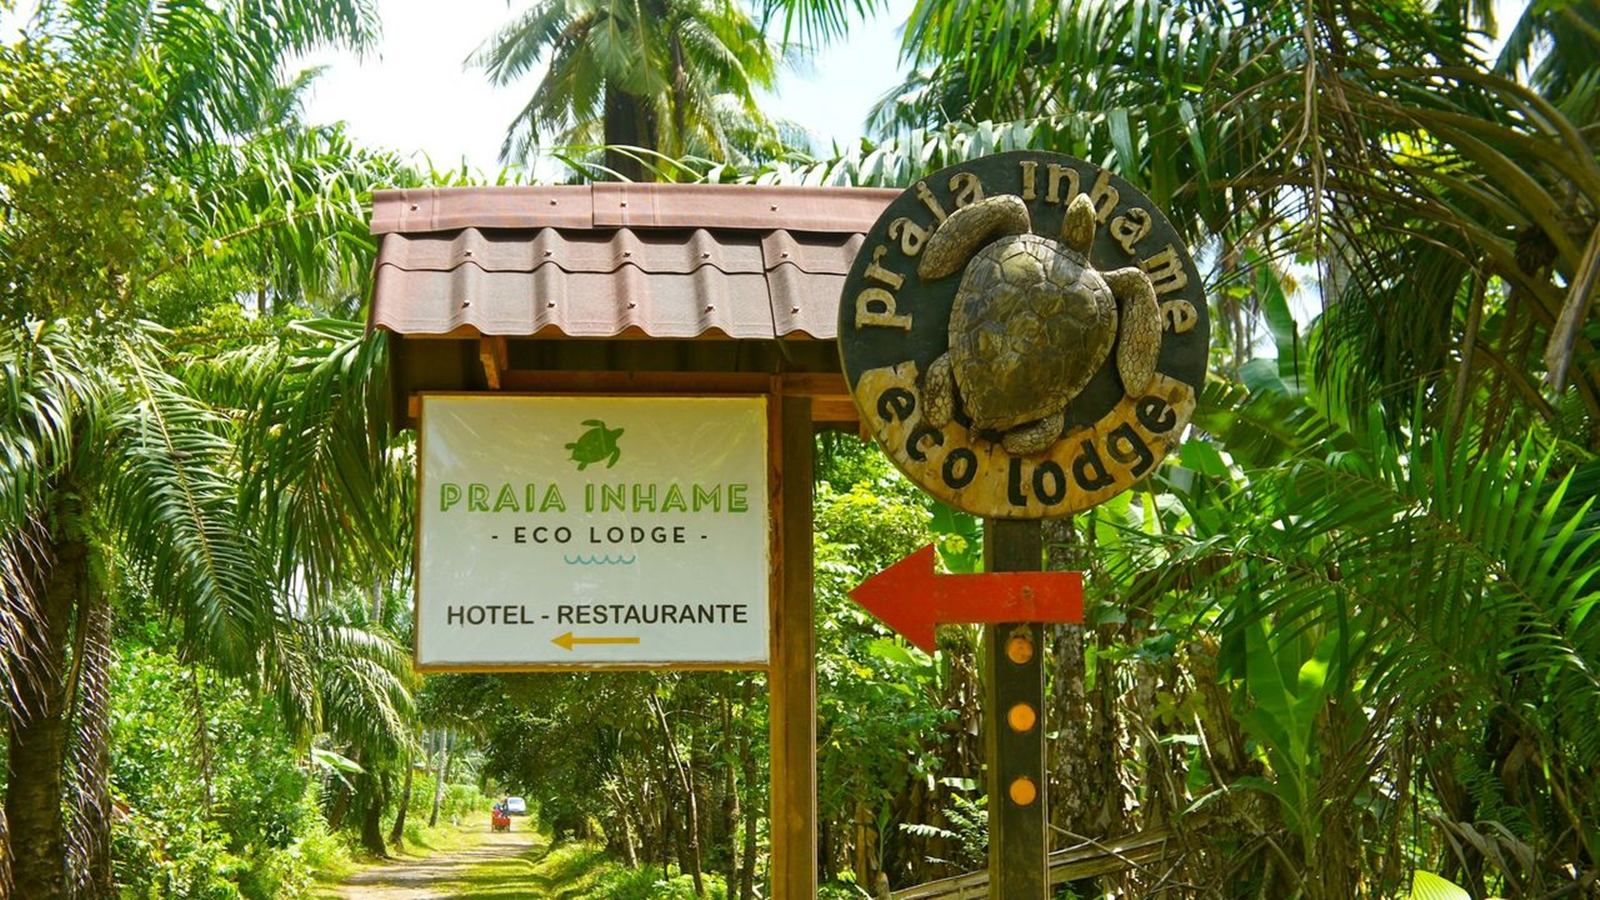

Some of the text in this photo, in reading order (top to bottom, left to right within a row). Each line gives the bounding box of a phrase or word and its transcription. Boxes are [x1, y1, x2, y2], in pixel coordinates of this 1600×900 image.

[876, 386, 1177, 507] eco lodge
[440, 483, 749, 513] PRAIA INHAME
[514, 526, 573, 544] ECO
[590, 526, 687, 544] LODGE
[447, 605, 535, 626] HOTEL
[556, 603, 749, 625] RESTAURANTE
